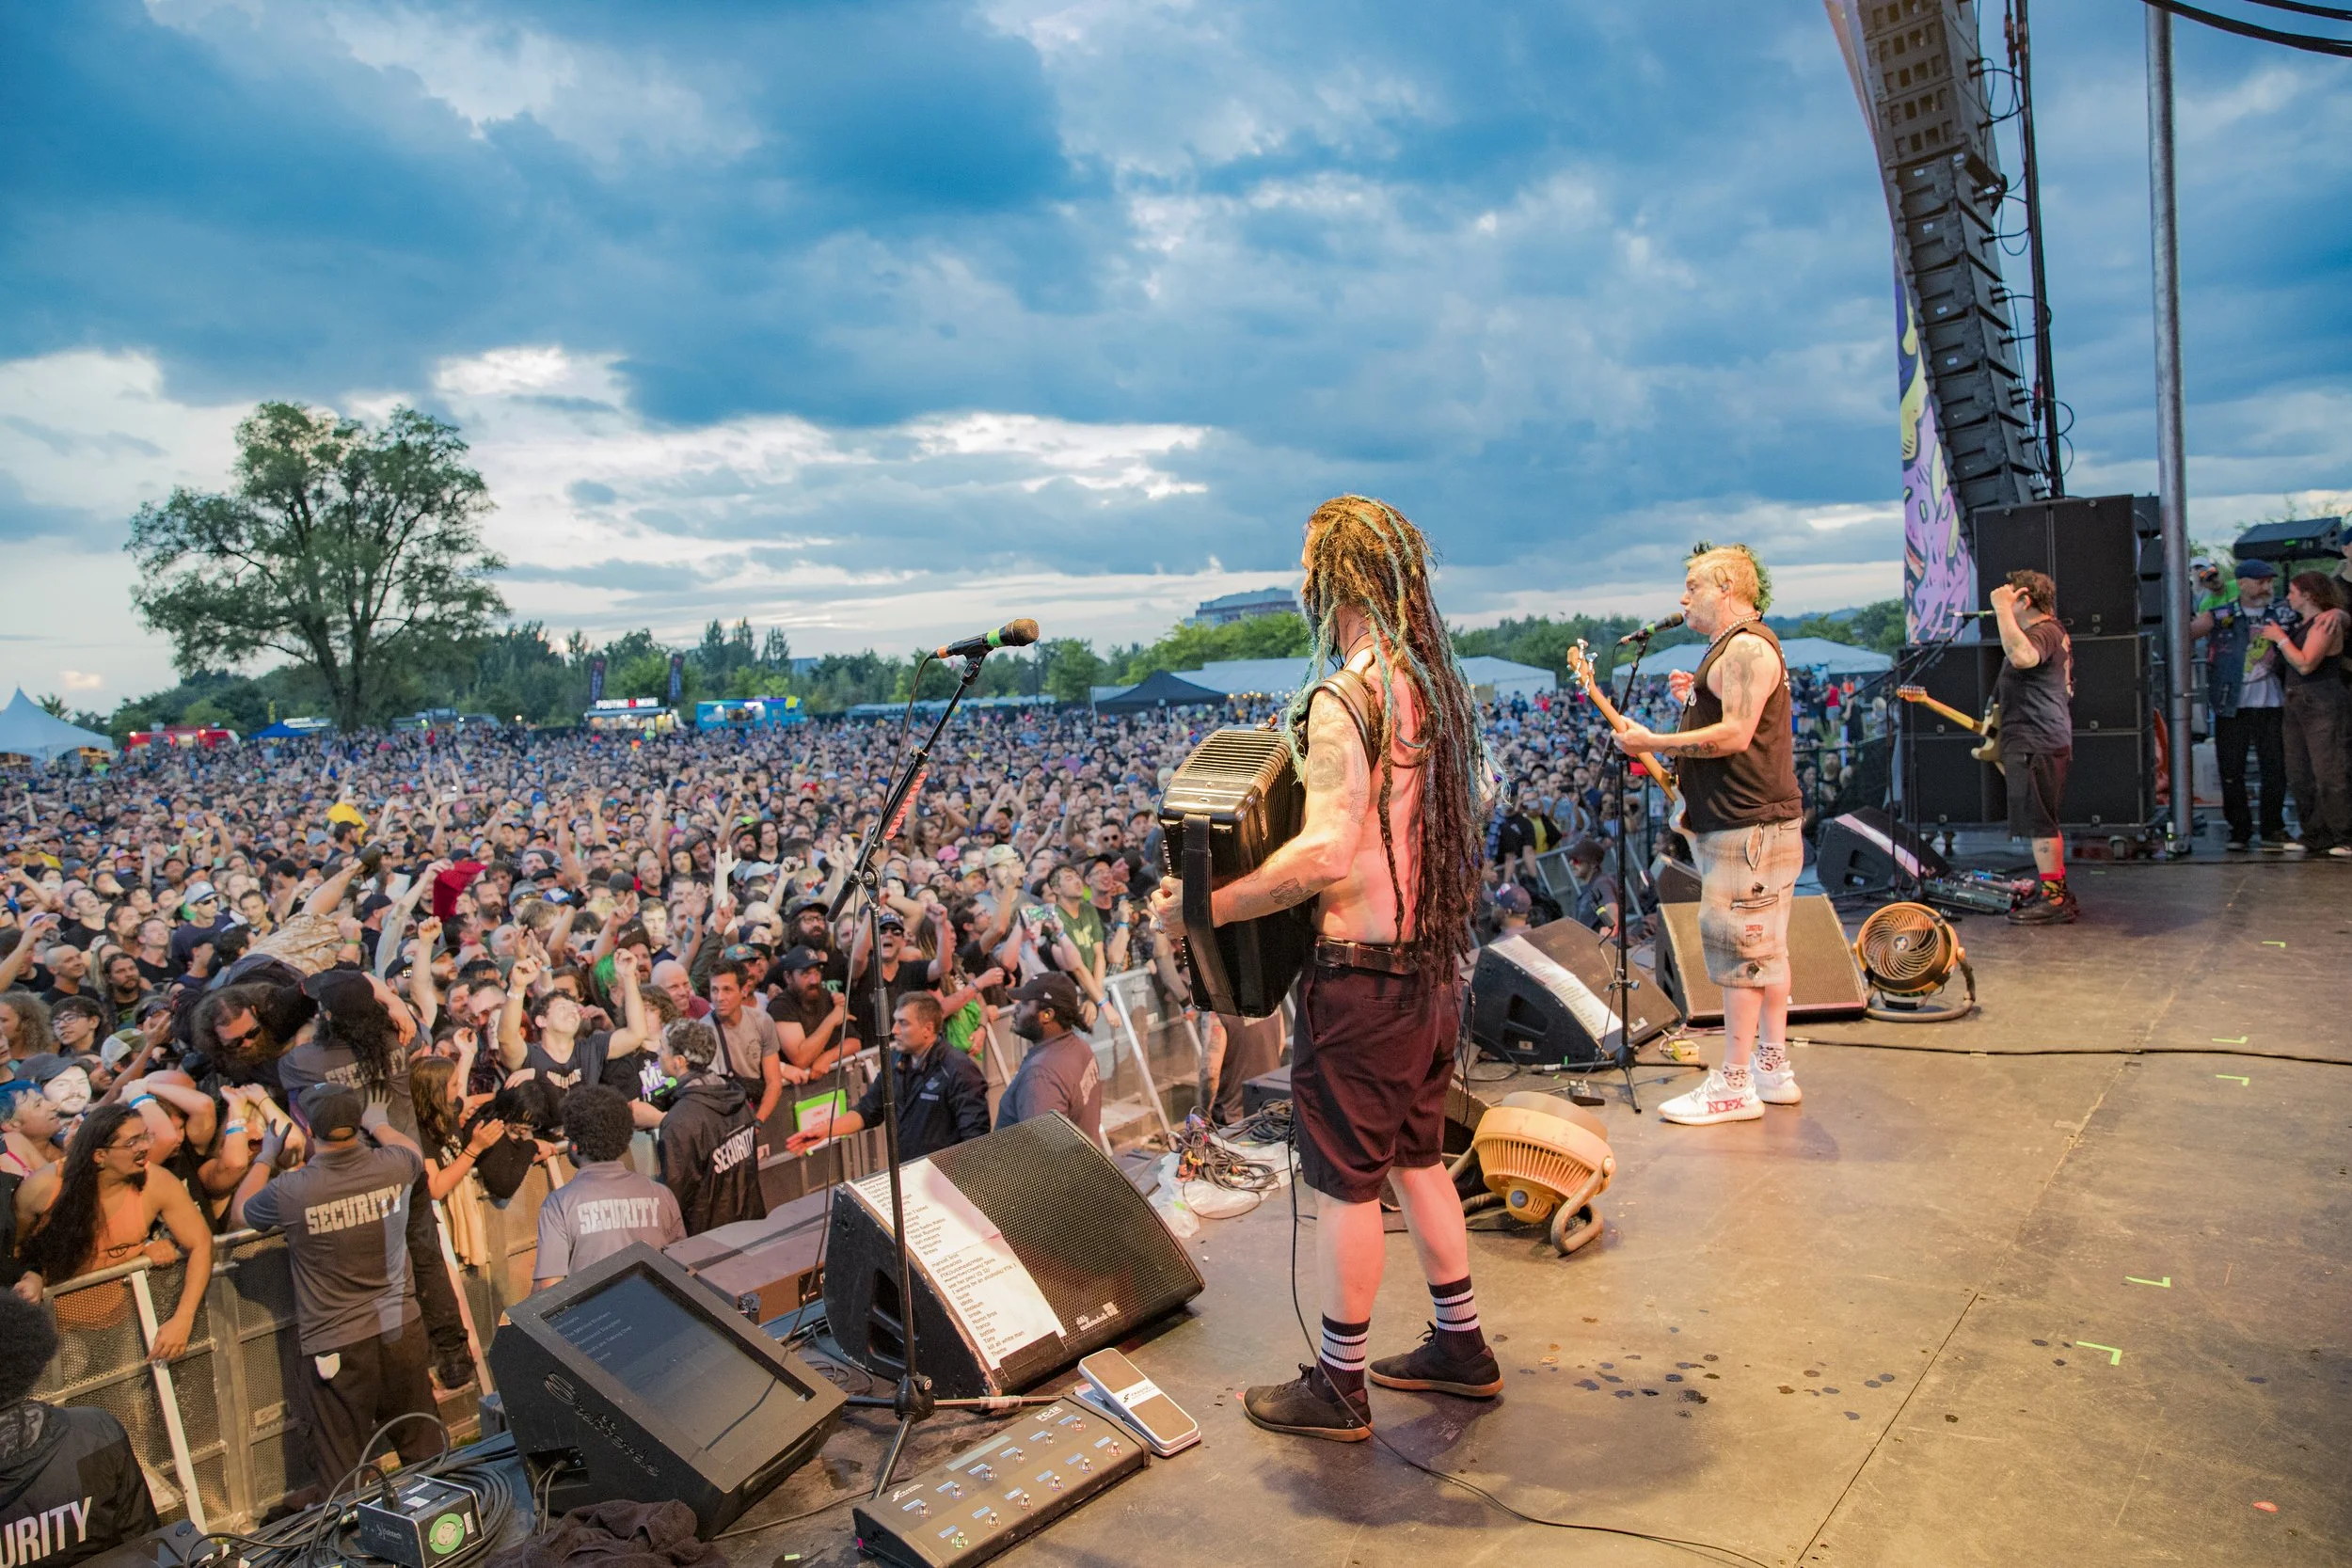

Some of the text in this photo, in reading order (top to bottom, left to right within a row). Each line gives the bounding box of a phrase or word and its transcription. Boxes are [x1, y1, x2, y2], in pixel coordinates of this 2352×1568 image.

[1707, 1098, 1745, 1114] NOFX
[712, 1126, 755, 1174] SECURITY
[305, 1183, 402, 1235] SECURITY
[577, 1197, 660, 1234] SECURITY
[0, 1496, 92, 1568] URITY
